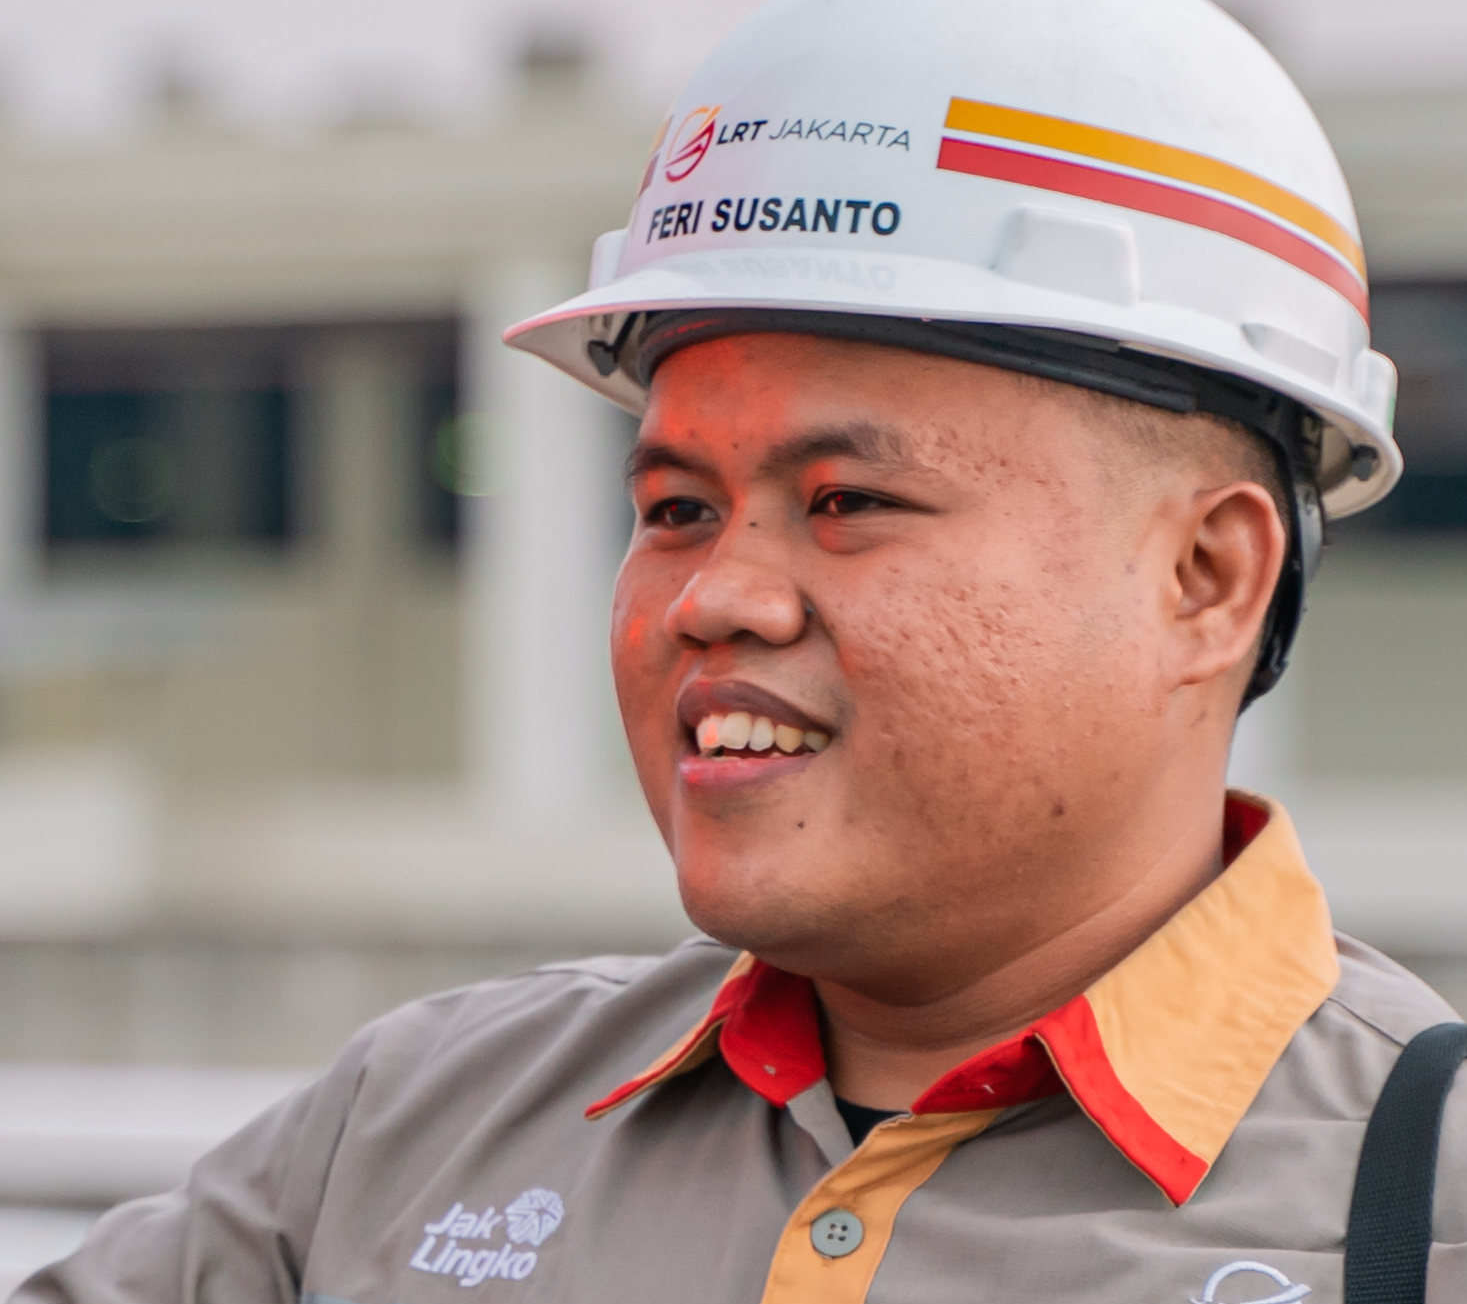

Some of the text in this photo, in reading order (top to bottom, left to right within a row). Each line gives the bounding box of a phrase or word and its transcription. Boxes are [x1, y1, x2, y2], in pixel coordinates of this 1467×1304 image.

[716, 118, 911, 152] LRT JAKARTA
[646, 196, 902, 245] FERI SUSANTO
[423, 1201, 504, 1240] Jak
[408, 1234, 539, 1288] Lingko
